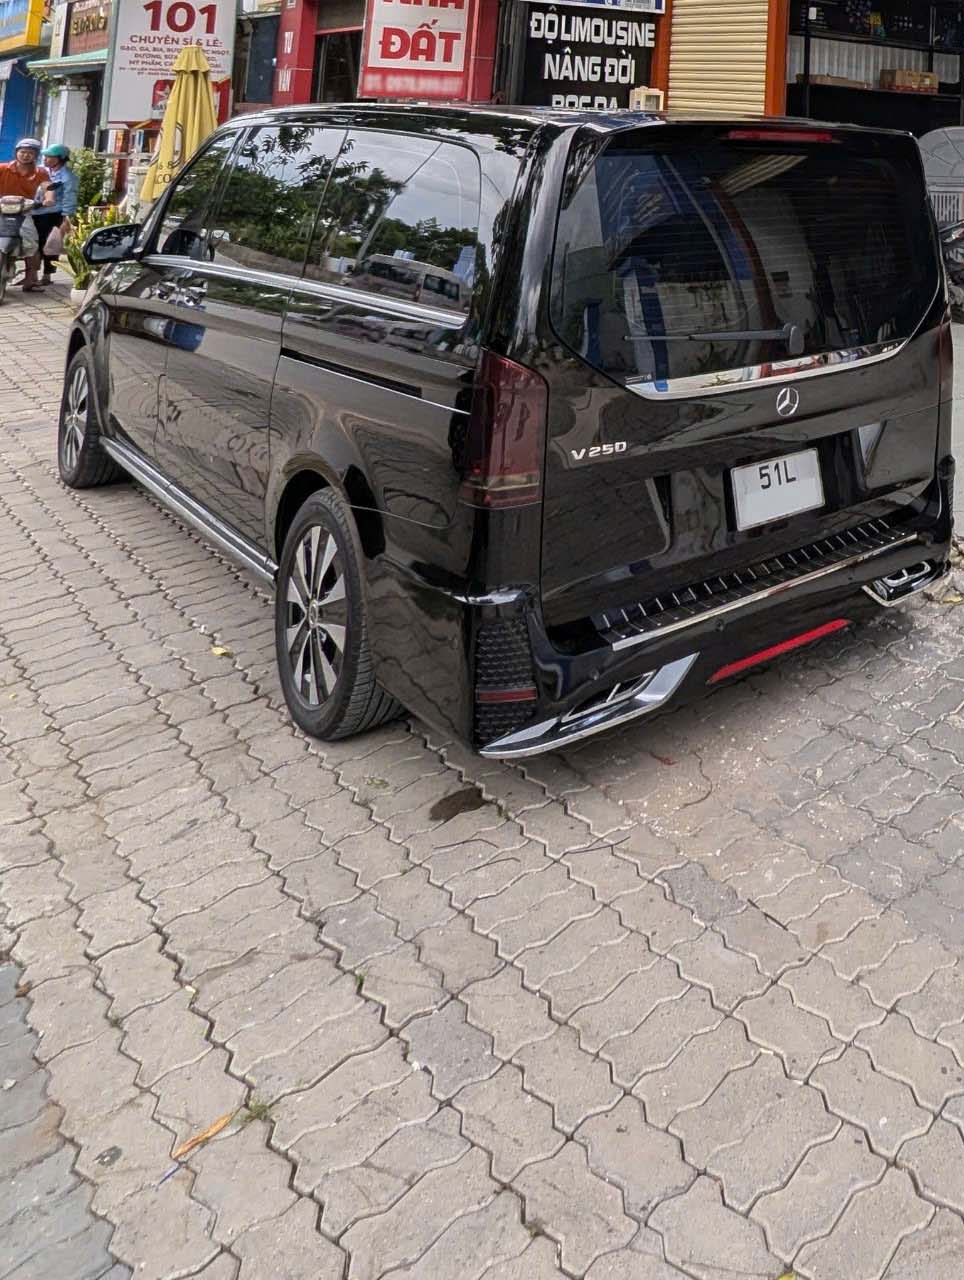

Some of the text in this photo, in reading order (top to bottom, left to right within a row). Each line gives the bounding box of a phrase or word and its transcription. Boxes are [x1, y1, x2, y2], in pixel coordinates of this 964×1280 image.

[143, 0, 217, 34] 101
[530, 5, 656, 48] ĐỘ LIMOUSINE
[129, 33, 180, 46] CHUYÊN
[379, 19, 461, 62] ĐẤT
[544, 46, 636, 84] NÂNG ĐỜI
[759, 460, 796, 490] 51L
